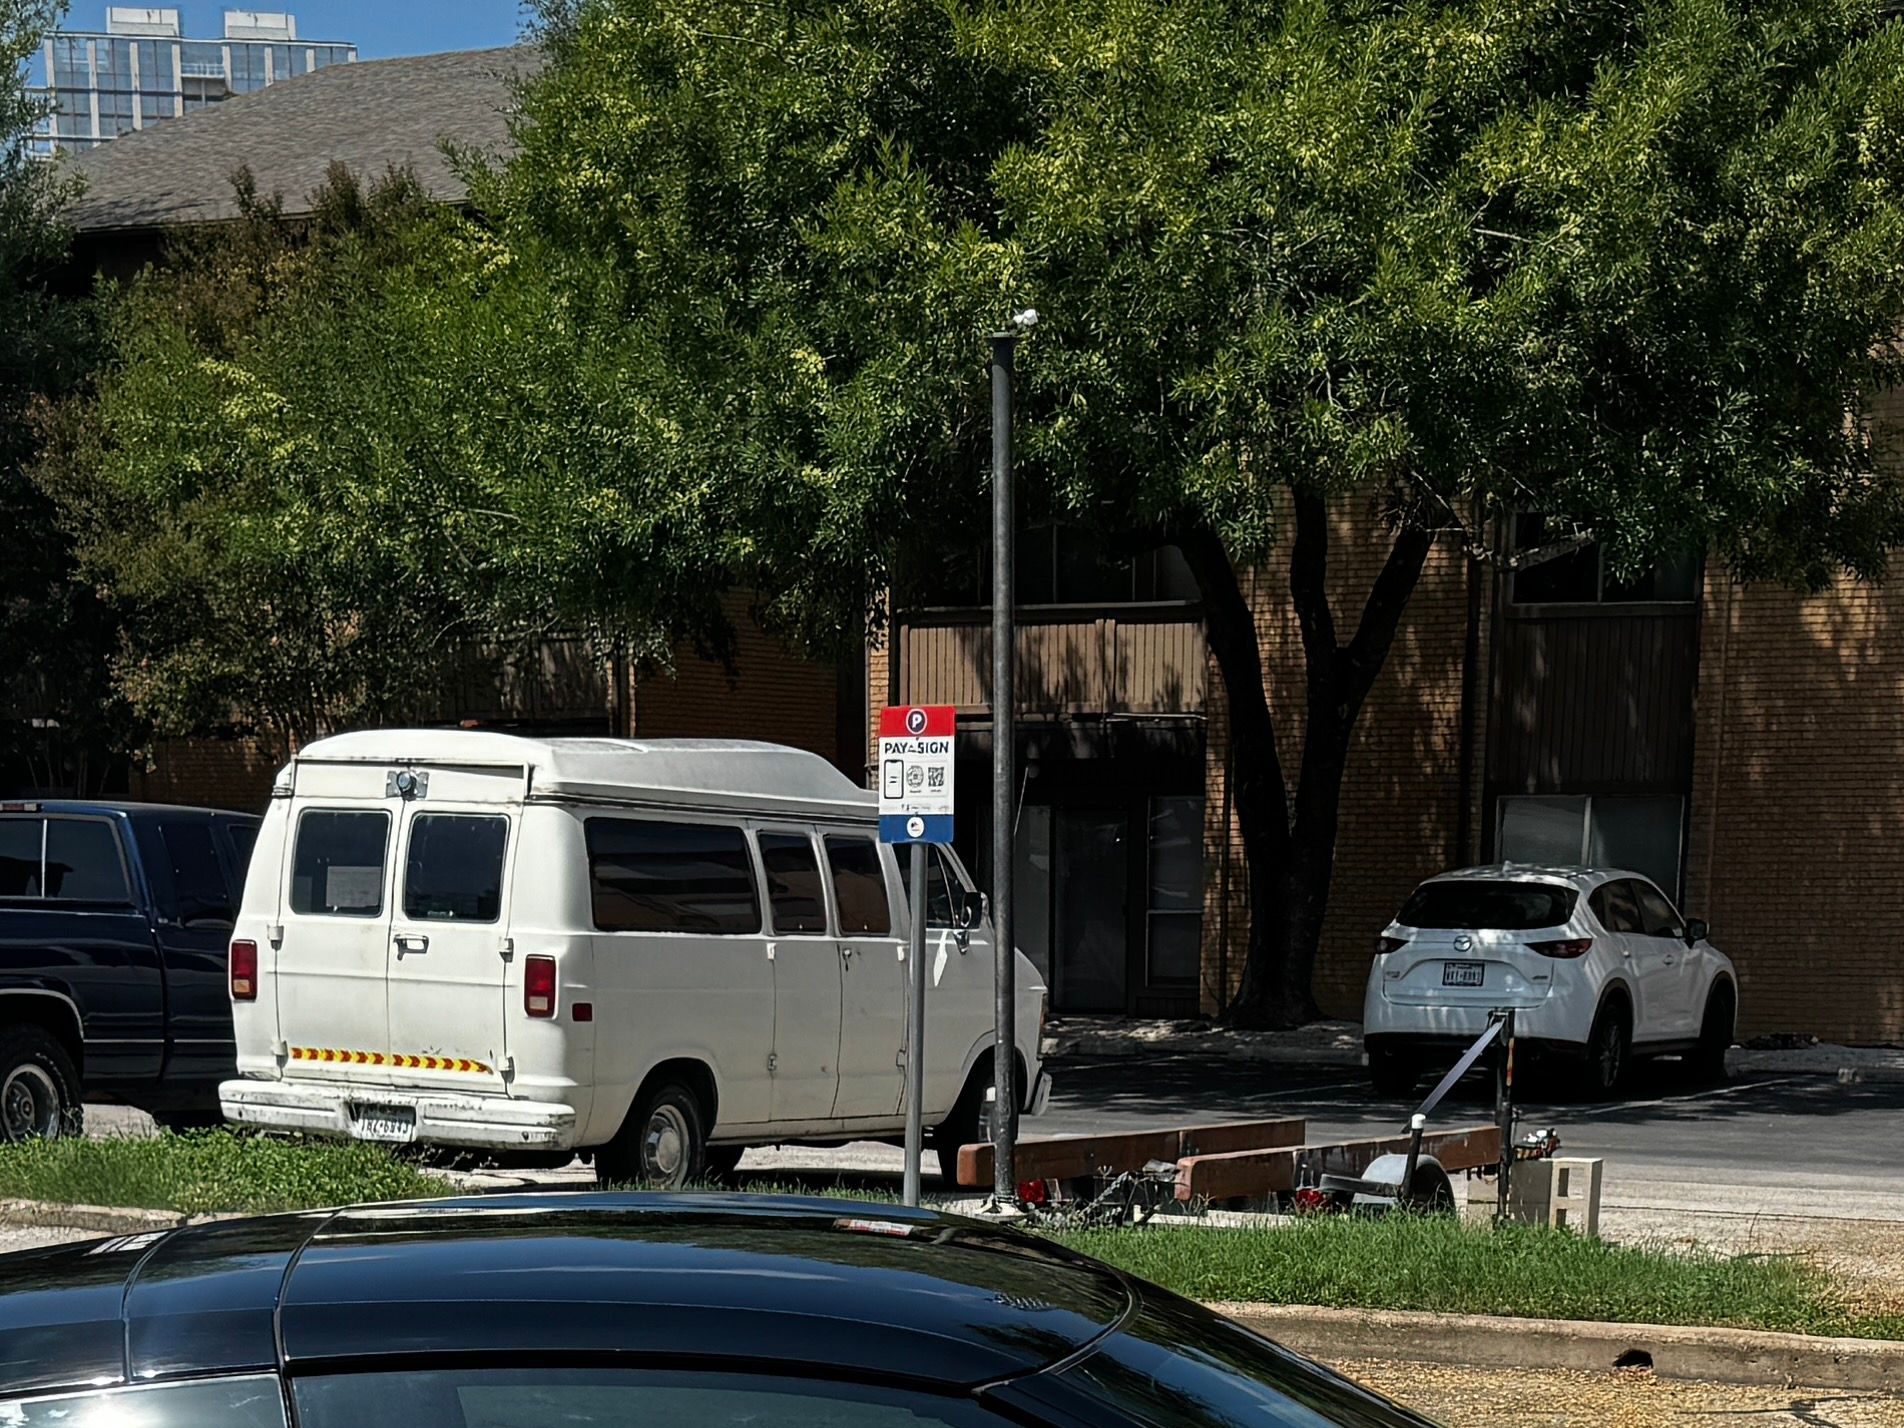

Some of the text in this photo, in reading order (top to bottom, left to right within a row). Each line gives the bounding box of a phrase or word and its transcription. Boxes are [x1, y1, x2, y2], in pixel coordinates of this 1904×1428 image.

[911, 714, 922, 729] P
[884, 741, 908, 754] PAY
[917, 741, 949, 754] SIGN
